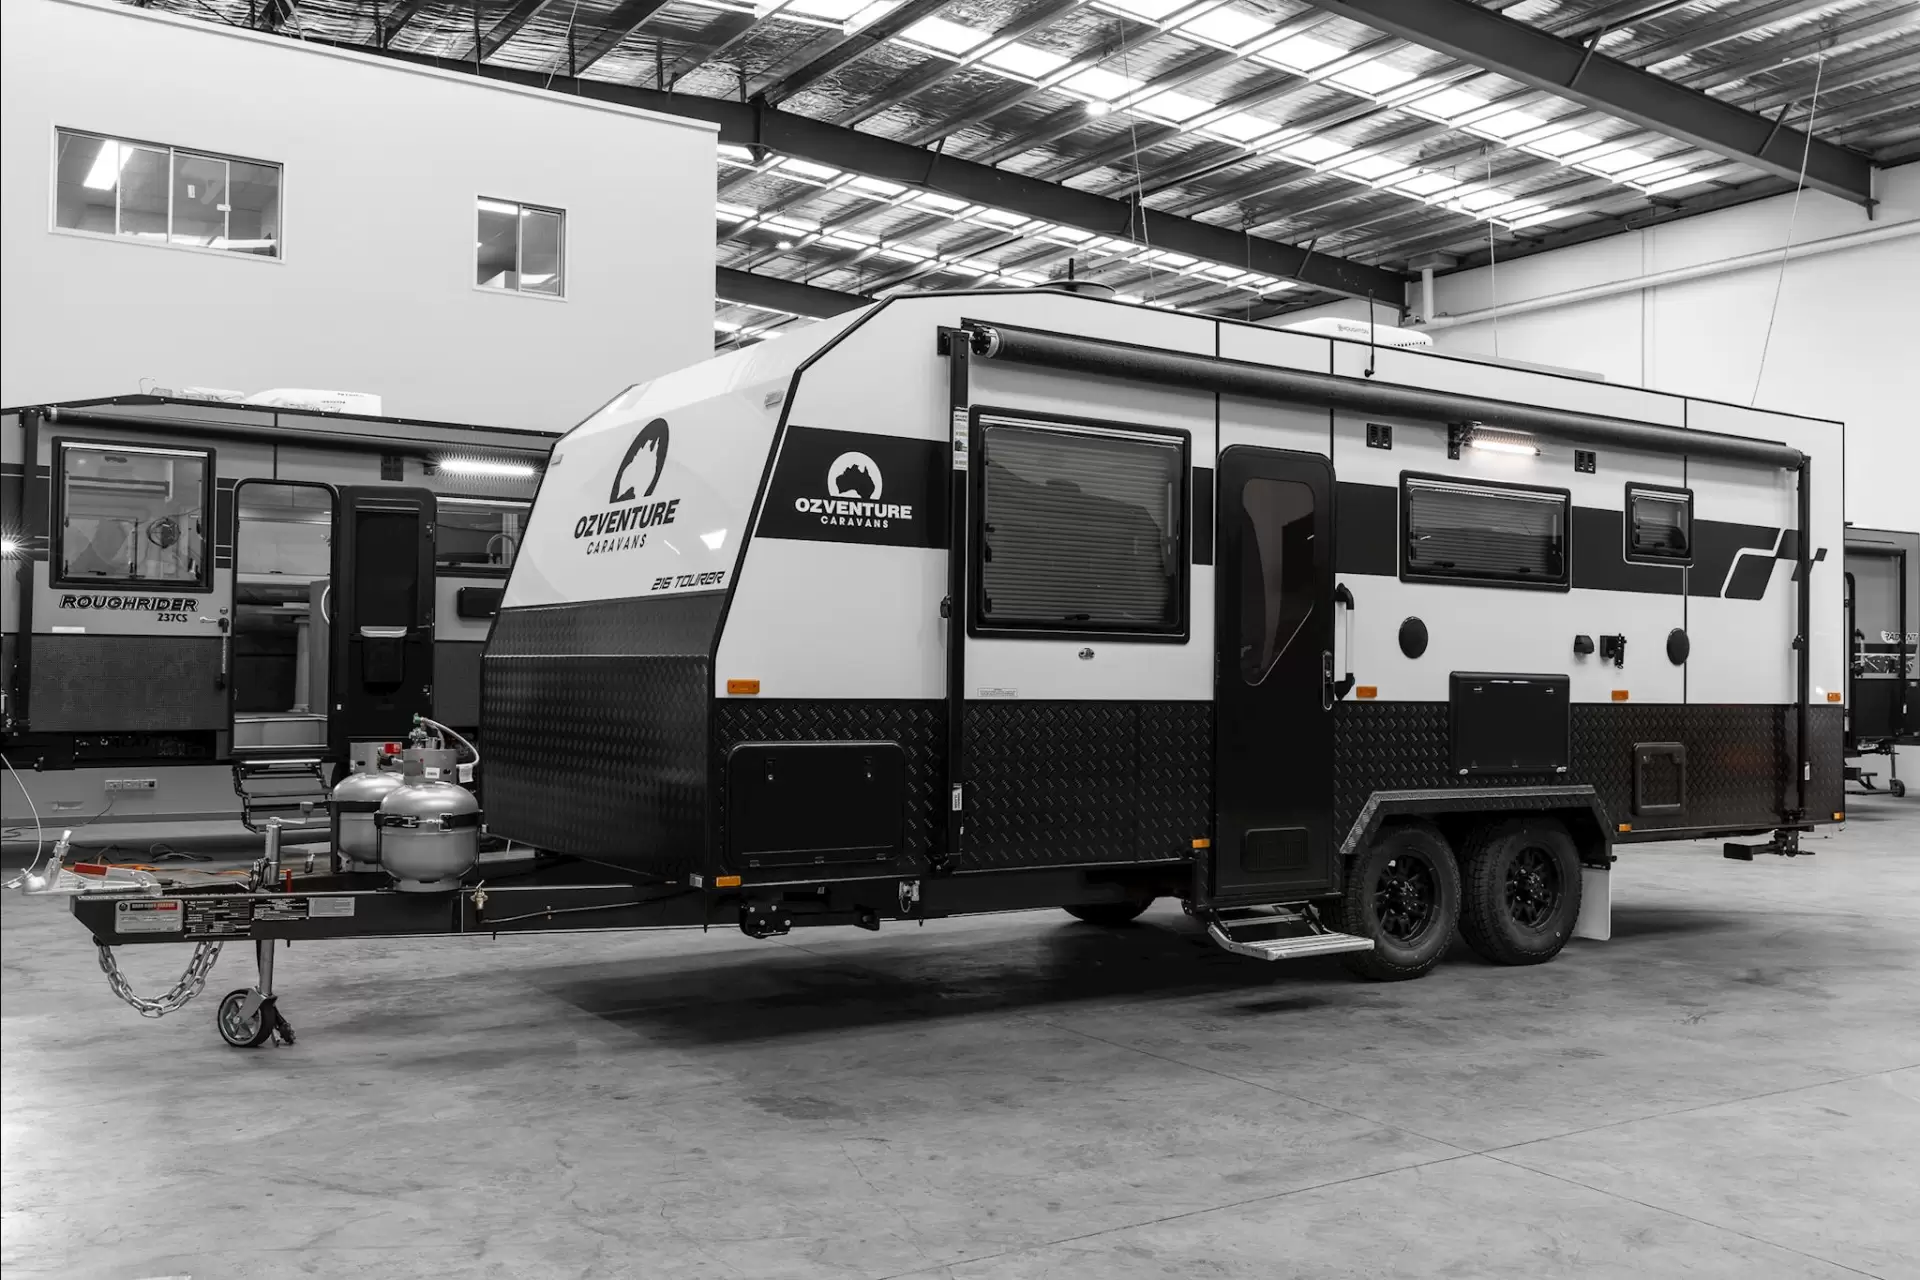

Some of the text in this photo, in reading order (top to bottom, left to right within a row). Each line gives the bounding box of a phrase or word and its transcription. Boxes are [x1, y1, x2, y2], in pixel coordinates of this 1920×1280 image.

[795, 497, 913, 520] OZVENTURE
[574, 499, 681, 539] OZVENTURE
[820, 515, 889, 529] CARAVANS
[586, 533, 647, 555] CARAVANS
[651, 570, 725, 591] 216 TOURER
[59, 594, 199, 612] ROUGHRIDER
[157, 612, 188, 622] 237CS
[1884, 632, 1918, 641] RADNT
